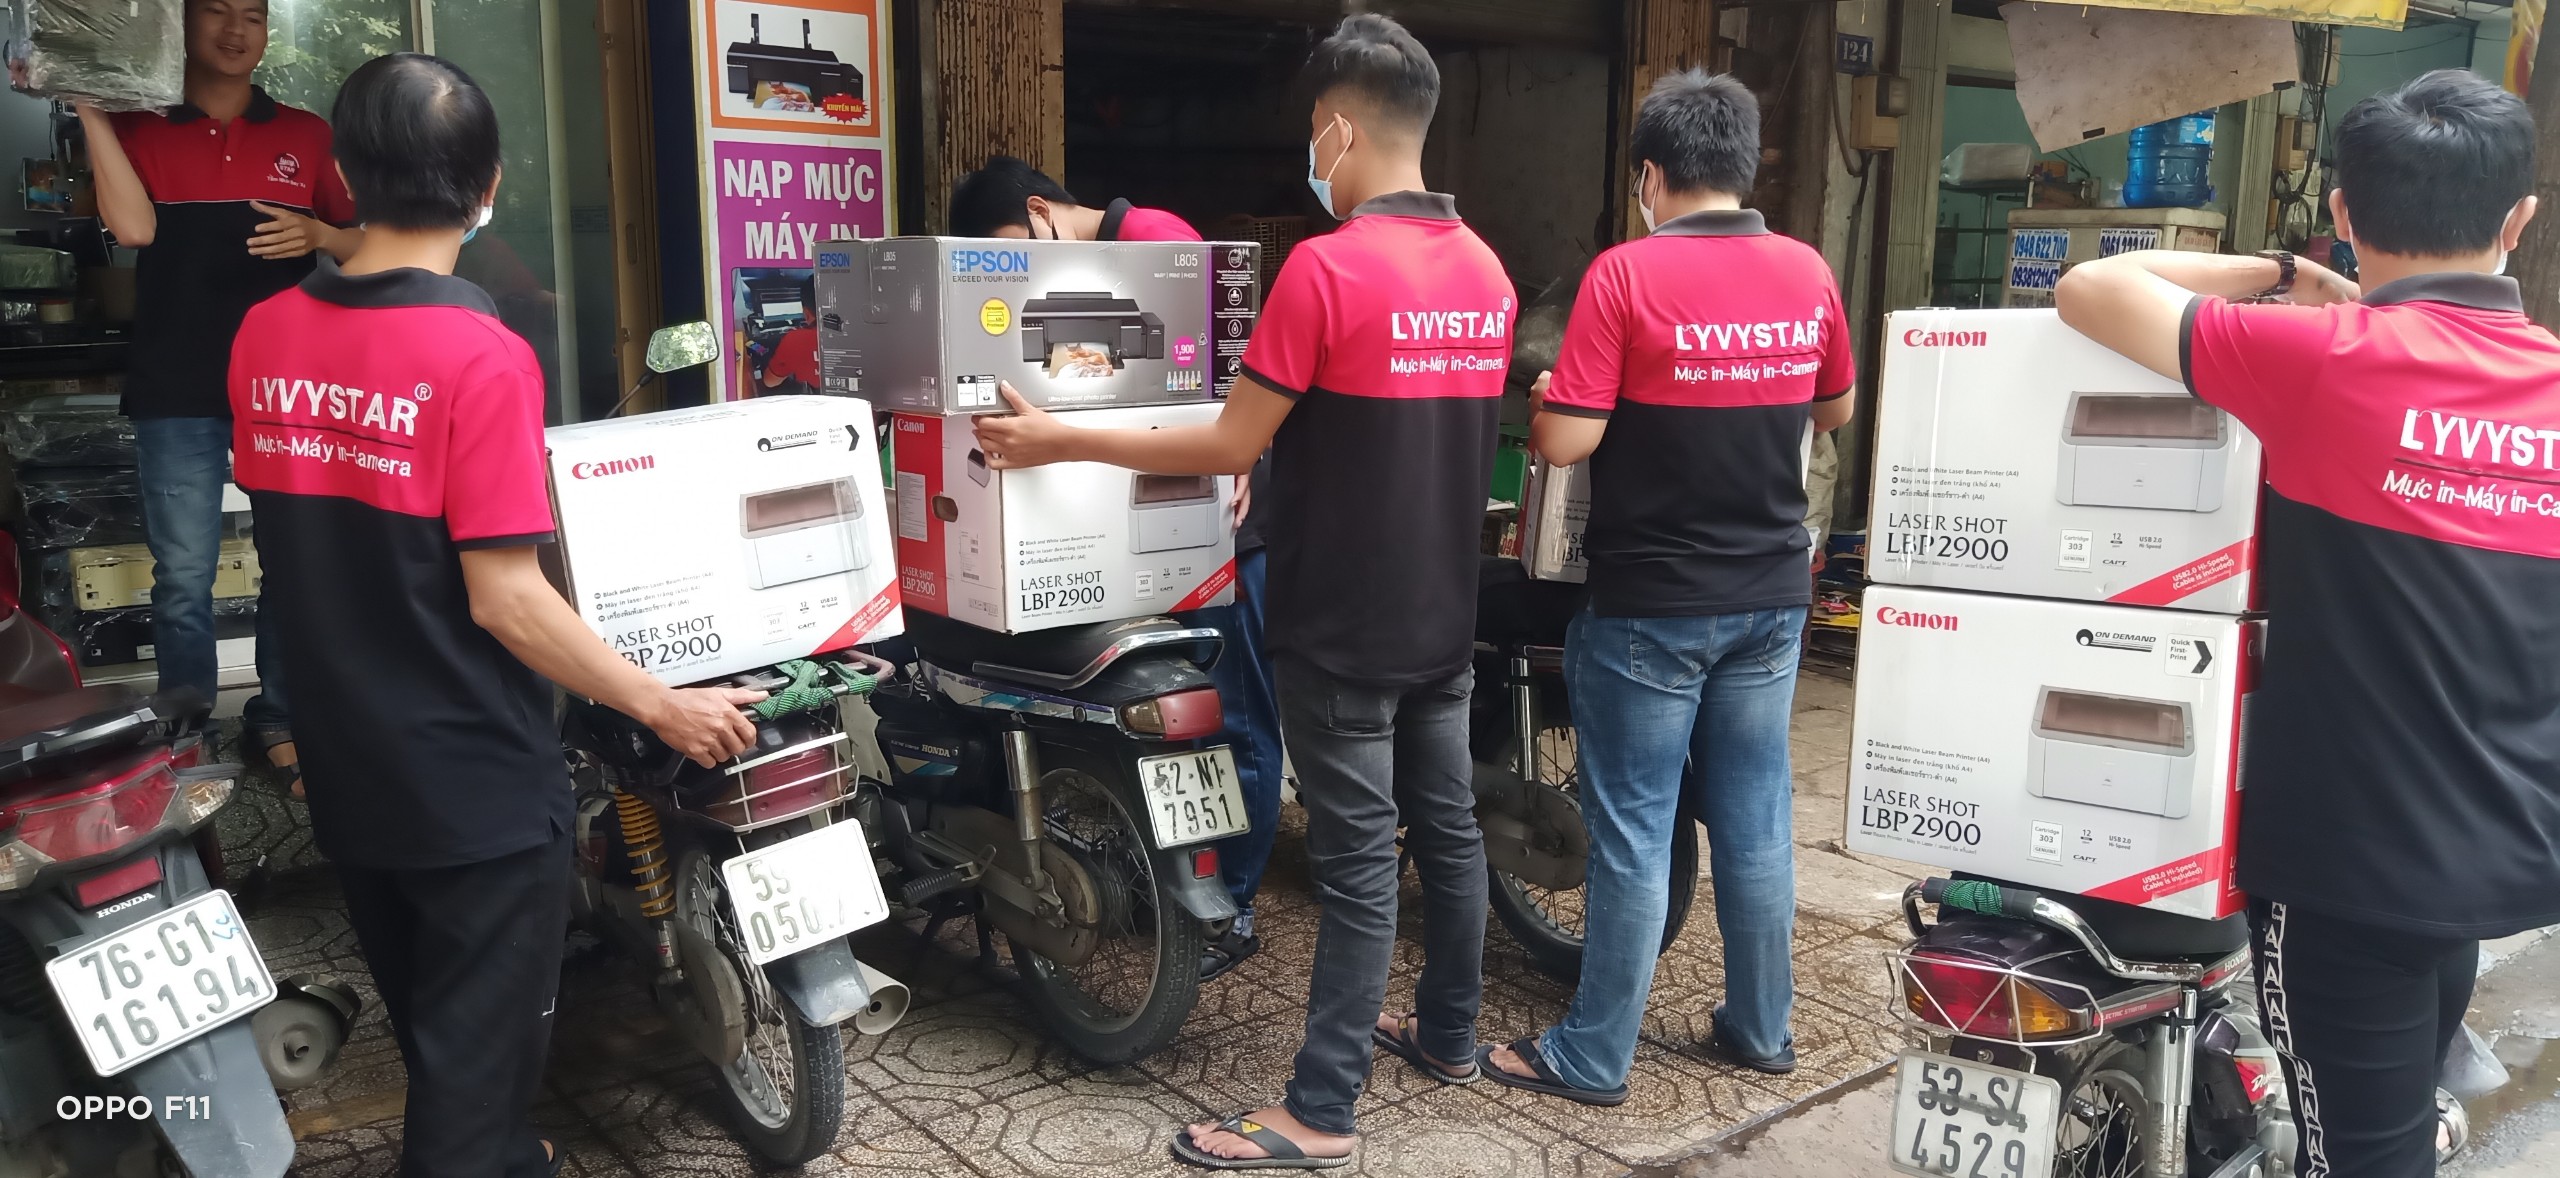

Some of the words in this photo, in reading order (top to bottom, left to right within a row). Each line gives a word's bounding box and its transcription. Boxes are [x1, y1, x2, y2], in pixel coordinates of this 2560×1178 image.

[1843, 40, 1868, 62] 124
[723, 158, 793, 206] NẠP
[804, 157, 875, 210] MỰC
[745, 212, 818, 260] MÁY
[820, 253, 850, 267] EPSON
[883, 251, 896, 261] L805
[952, 250, 1029, 273] EPSON
[1174, 254, 1198, 267] L805
[1391, 311, 1506, 340] LYVYSTAR
[1675, 321, 1819, 351] LYVYSTAR
[1904, 329, 1987, 347] Canon
[1174, 344, 1195, 355] 1,900
[1390, 356, 1418, 377] Mực
[1674, 366, 1707, 384] Mực
[252, 377, 419, 437] LYVYSTAR
[785, 430, 818, 441] DEMAND
[897, 418, 924, 433] Canon
[572, 455, 654, 480] Canon
[2382, 469, 2433, 503] Mực
[1889, 512, 1947, 531] LASER
[1953, 516, 2008, 534] SHOT
[2064, 534, 2089, 542] Cartridge
[2068, 543, 2083, 551] 303
[902, 565, 918, 577] LASER
[919, 569, 934, 581] SHOT
[2172, 567, 2197, 582] USB2.0
[2198, 553, 2229, 570] Hi-Speed
[902, 576, 935, 596] LBP2900
[1021, 575, 1063, 590] LASER
[1067, 570, 1102, 585] SHOT
[2172, 575, 2195, 590] (Cable
[603, 589, 618, 598] Black
[1021, 585, 1104, 612] LBP2900
[1877, 607, 1957, 631] Canon
[603, 627, 662, 650] ASER
[666, 615, 714, 638] SHOT
[2095, 631, 2110, 639] ON
[2112, 632, 2156, 643] DEMAND
[2171, 638, 2190, 646] Quick
[621, 633, 721, 669] BP2900
[2170, 653, 2187, 661] Print
[922, 744, 950, 758] HONDA
[1903, 745, 1920, 753] White
[1956, 753, 1976, 761] Printer
[1977, 756, 1991, 764] (A4)
[1945, 776, 1958, 784] (A4)
[1864, 786, 1920, 809] LASER
[1926, 796, 1979, 819] SHOT
[1163, 793, 1233, 840] 7951
[1862, 805, 1981, 846] LBP2900
[2035, 826, 2059, 835] Cartridge
[2039, 834, 2054, 843] 303
[2082, 829, 2091, 837] 12
[2109, 835, 2122, 843] USB
[2142, 871, 2166, 884] USB2.0
[2167, 861, 2197, 877] Hi-Speed
[2143, 881, 2164, 892] (Cable
[2172, 867, 2203, 882] included)
[96, 891, 156, 919] HONDA
[79, 909, 217, 1002] 76-G1
[2224, 950, 2249, 972] HONDA
[93, 955, 261, 1061] 161.94
[2099, 1009, 2123, 1021] LECTRIC
[1911, 1117, 2026, 1178] 4529
